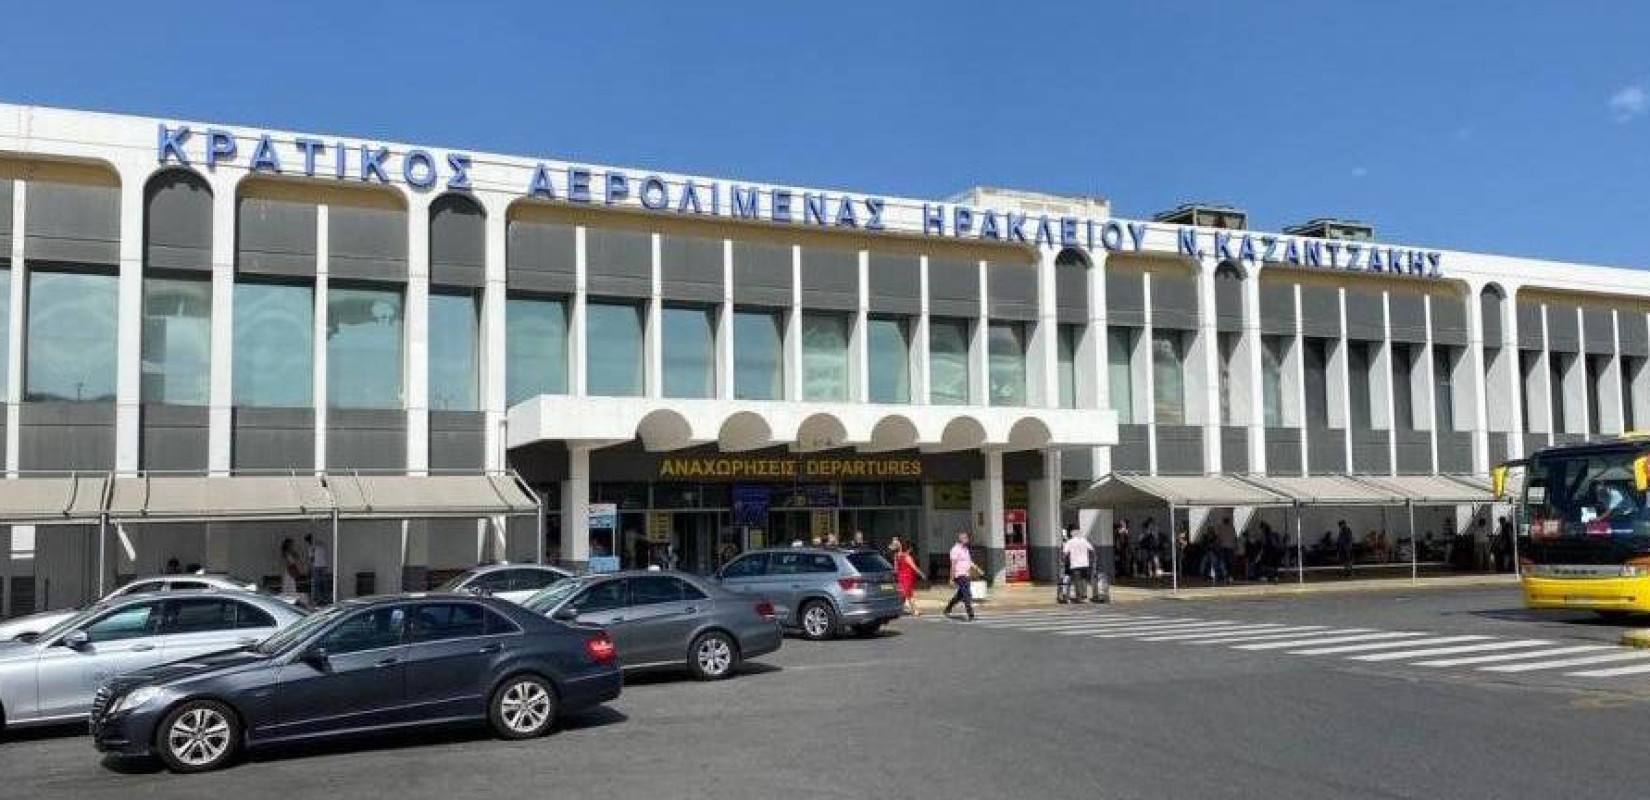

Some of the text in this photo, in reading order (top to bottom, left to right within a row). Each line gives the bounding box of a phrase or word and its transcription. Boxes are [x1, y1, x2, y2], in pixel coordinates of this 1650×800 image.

[158, 124, 471, 191] ΚΡΑΤΙΚΟΣ
[527, 163, 886, 230] ΑΕΡΟΛΙΜΕΝΑΣ
[922, 203, 1147, 252] ΗΡΑΚΛΕΙΟΥ
[660, 459, 923, 476] ΑΝΑΧΩΡΗΣΕΙΣ DEPARTURES
